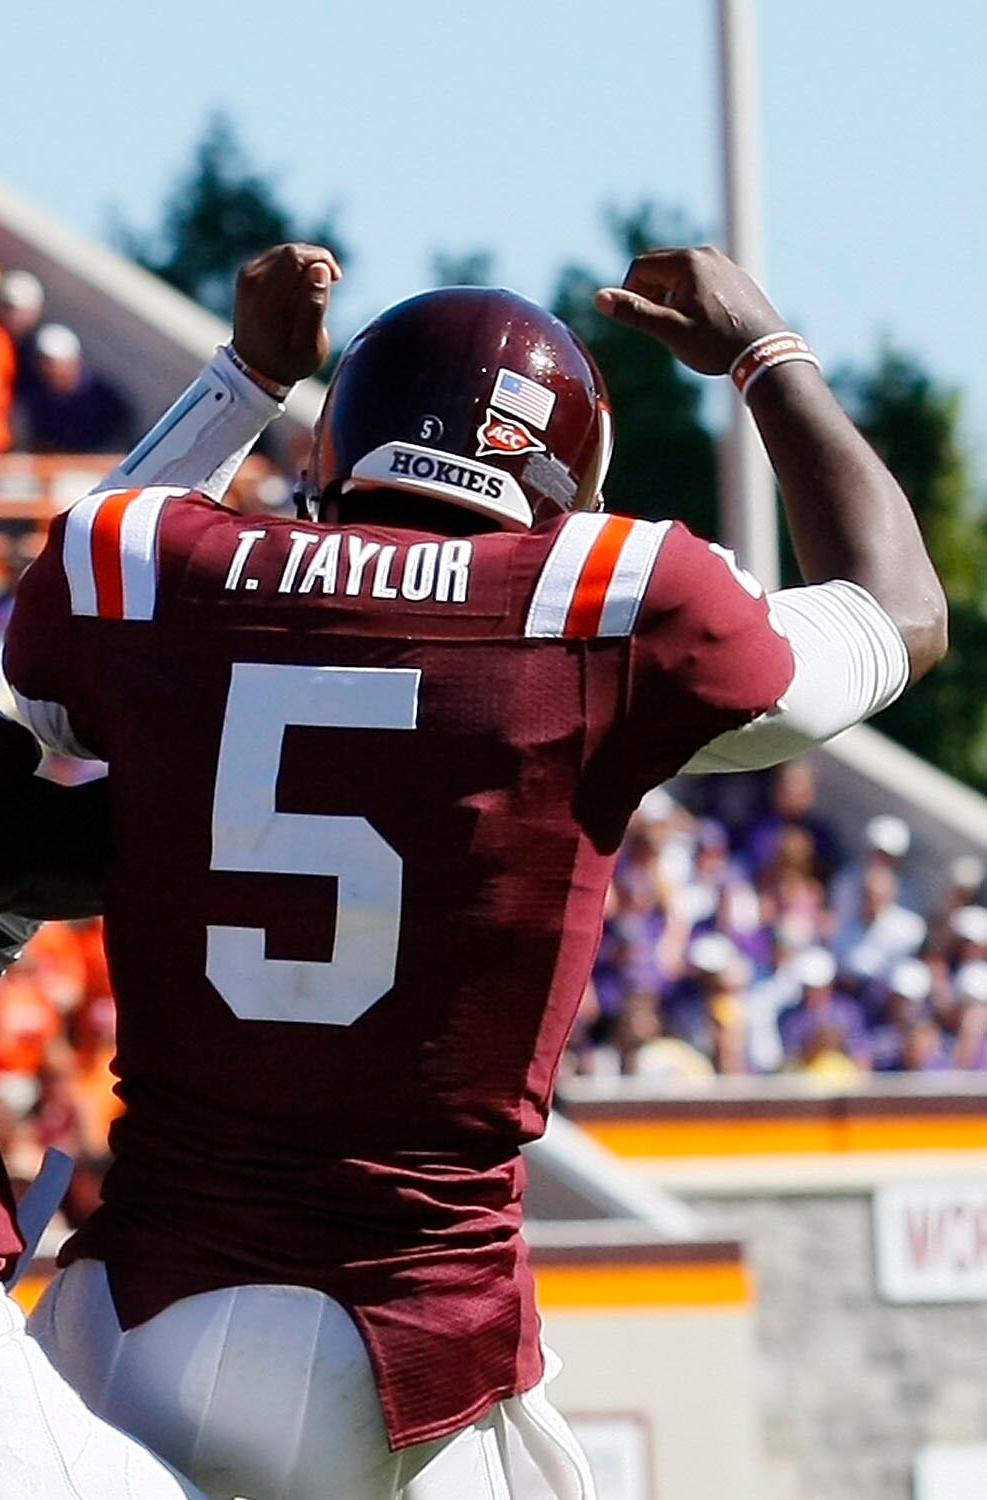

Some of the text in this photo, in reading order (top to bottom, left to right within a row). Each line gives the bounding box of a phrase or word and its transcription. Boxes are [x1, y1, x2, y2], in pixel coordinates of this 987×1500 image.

[420, 420, 434, 439] 5
[486, 425, 523, 449] ACC
[389, 450, 503, 499] HOKIES
[224, 530, 473, 603] T. TAYLOR
[205, 662, 422, 1027] 5
